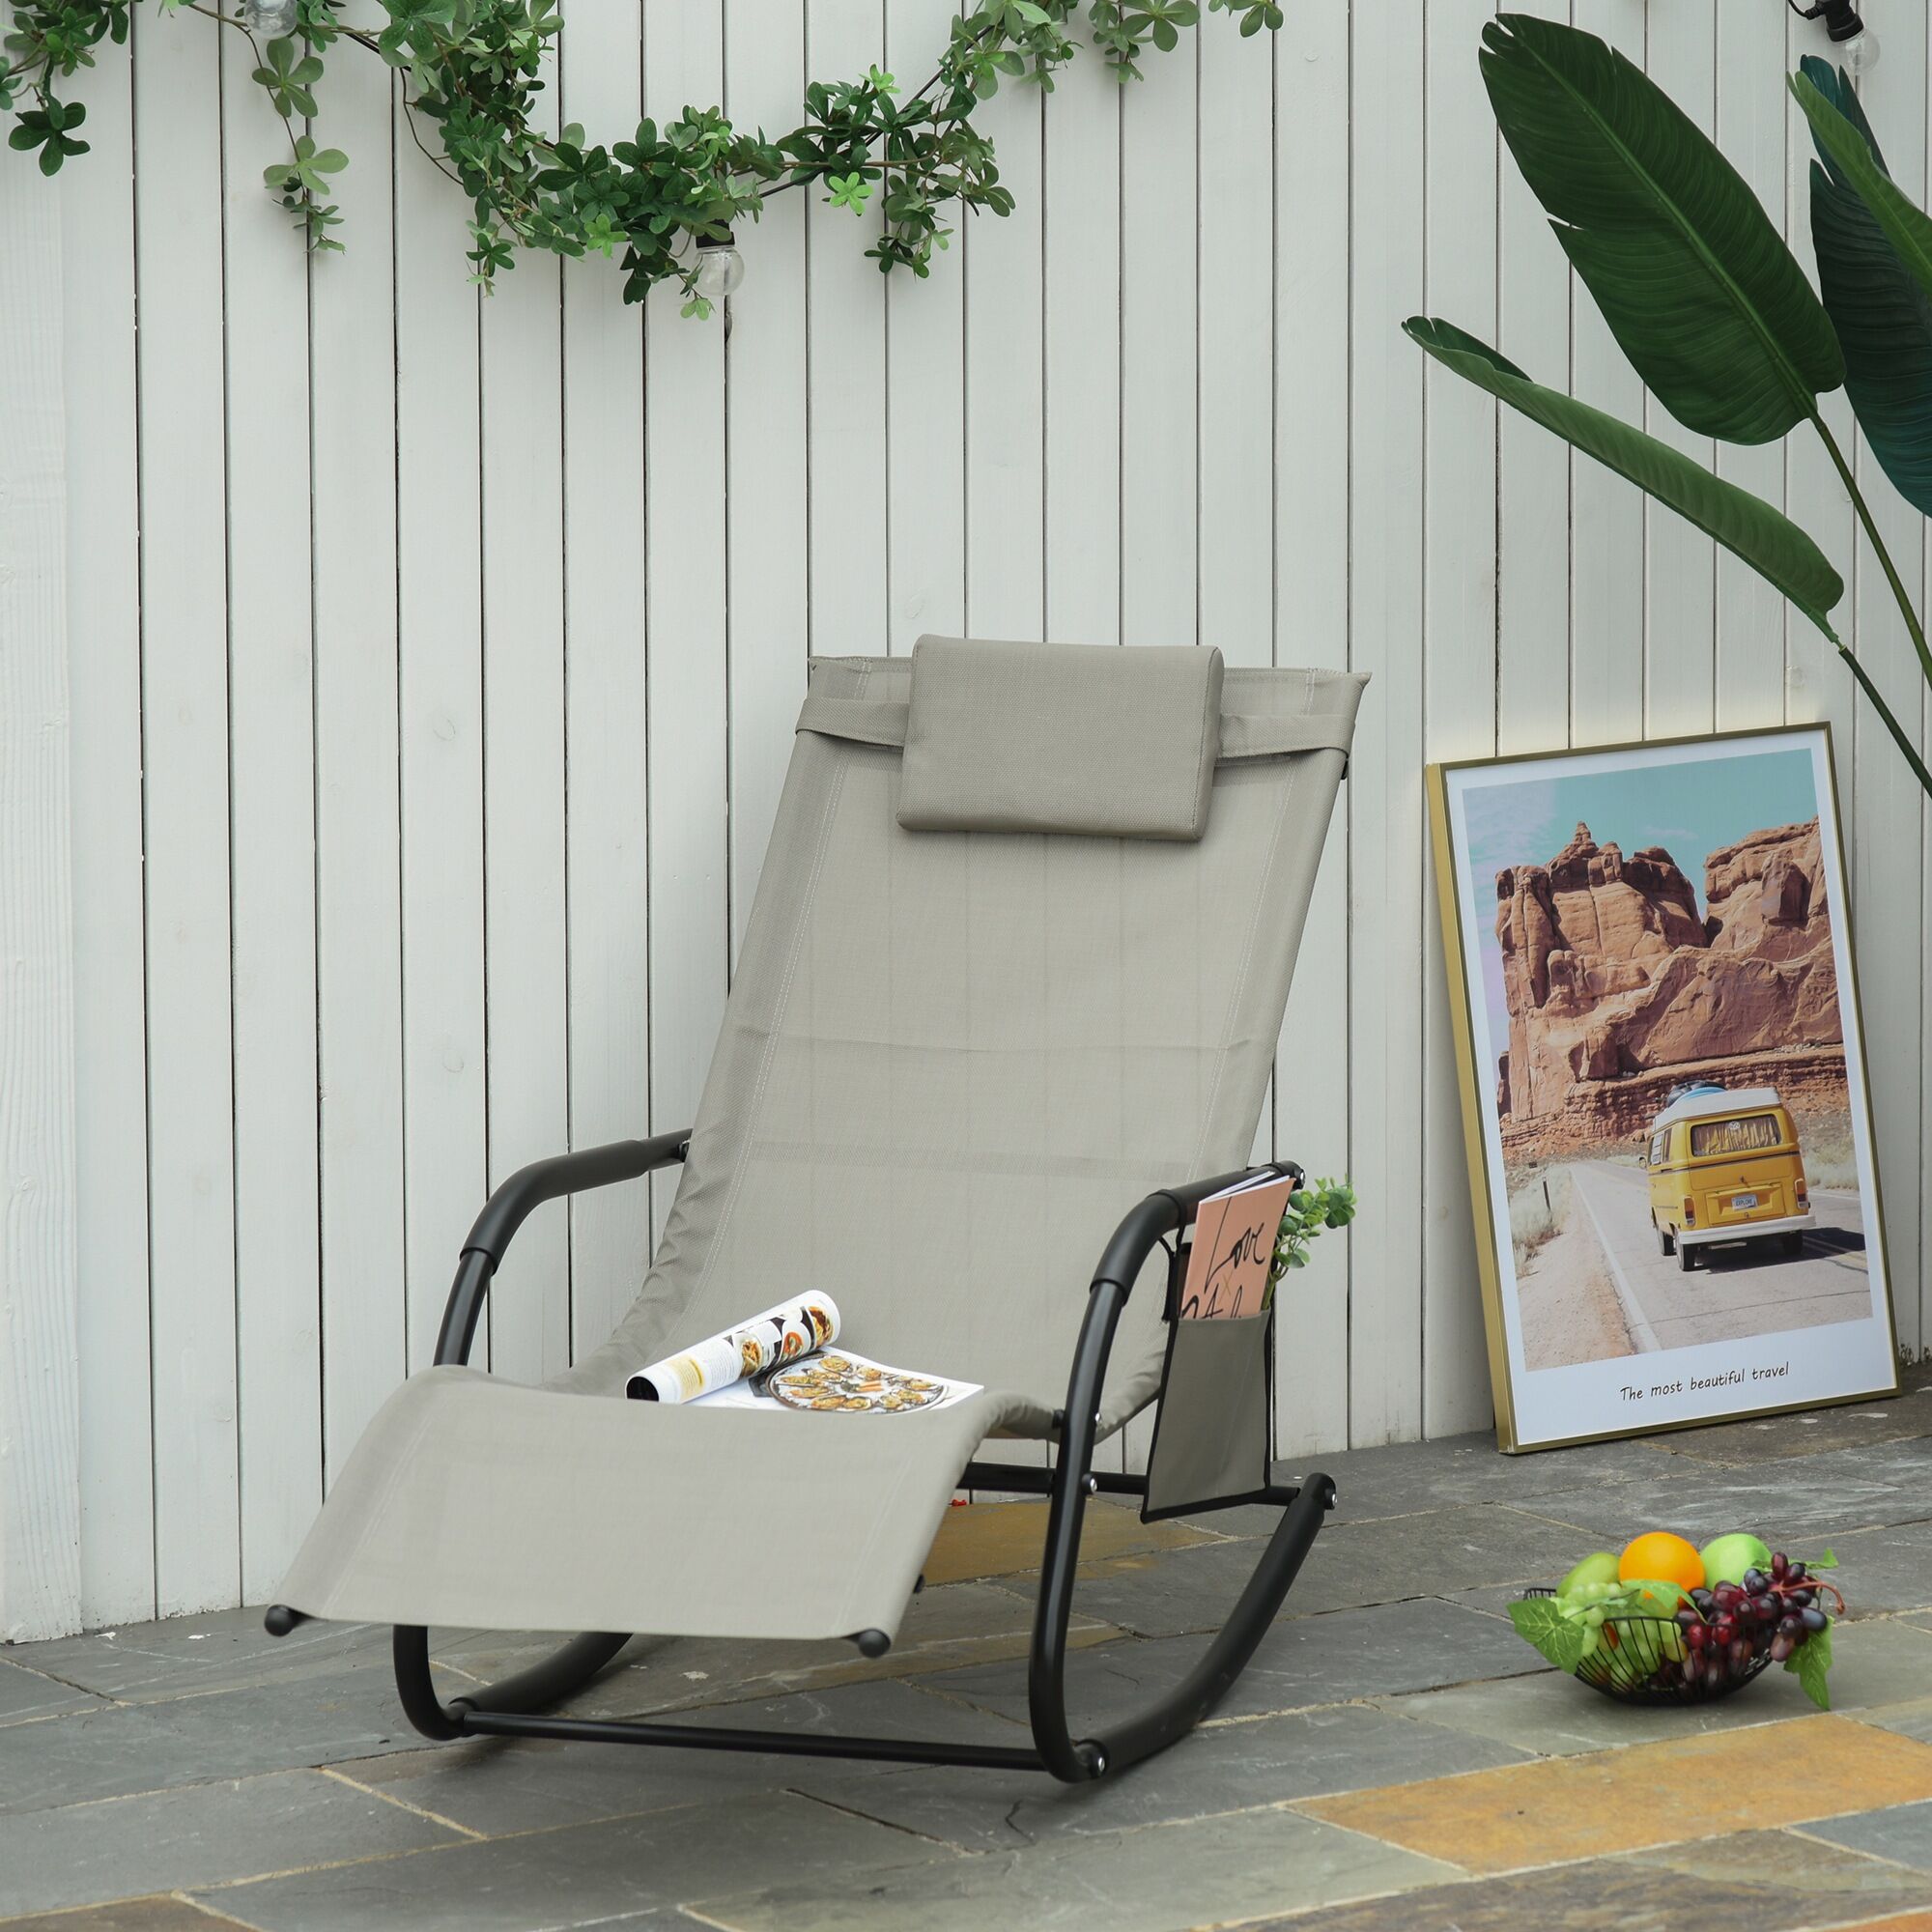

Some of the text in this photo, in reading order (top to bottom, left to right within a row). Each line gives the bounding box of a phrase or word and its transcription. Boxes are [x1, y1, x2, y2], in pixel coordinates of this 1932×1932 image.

[1620, 1361, 1790, 1402] The most beautiful travel
